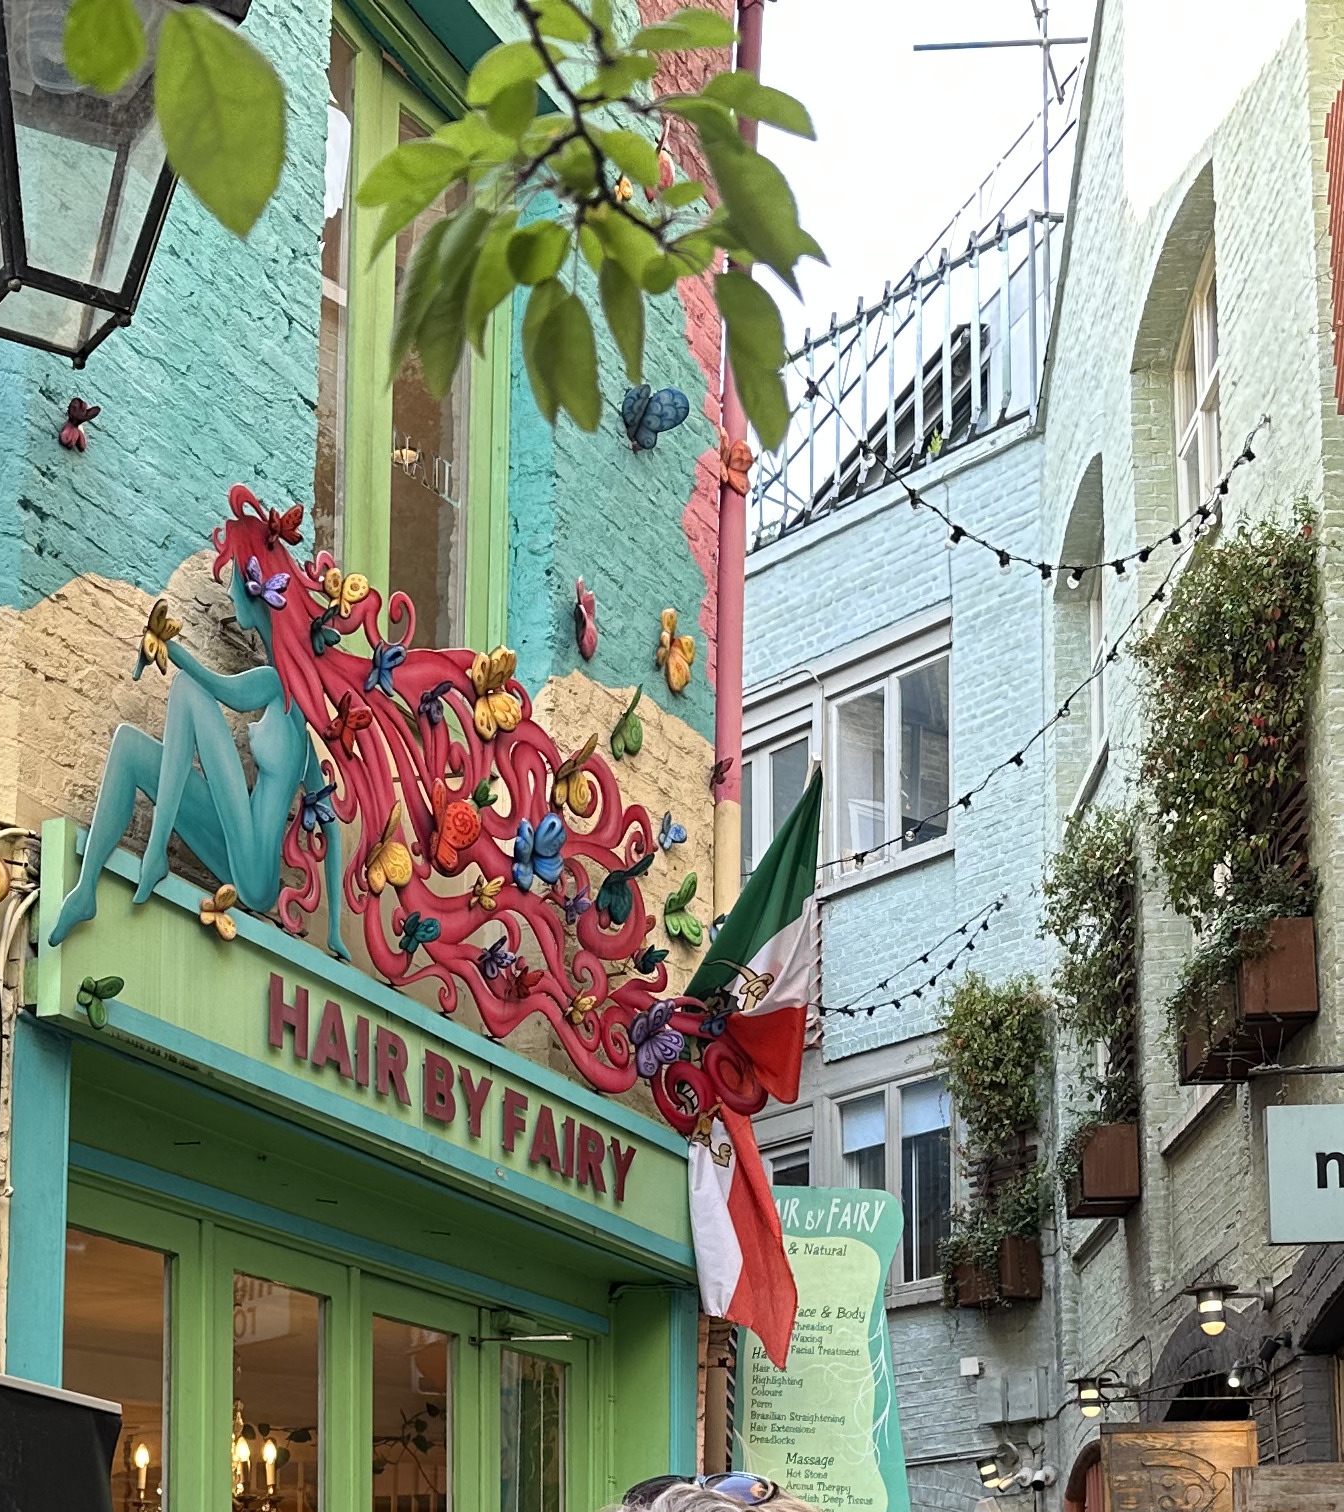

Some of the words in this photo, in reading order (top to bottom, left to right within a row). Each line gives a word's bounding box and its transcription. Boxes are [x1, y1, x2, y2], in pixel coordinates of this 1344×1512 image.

[268, 972, 411, 1107] HAIR
[423, 1048, 493, 1139] BY
[502, 1086, 636, 1202] FAIRY
[805, 1208, 825, 1230] BY
[826, 1198, 886, 1233] FAIRY
[804, 1243, 847, 1256] Natural
[796, 1306, 817, 1318] ace
[821, 1306, 832, 1318] &
[836, 1307, 866, 1323] Body
[791, 1332, 823, 1345] Waxing
[791, 1345, 814, 1355] Facial
[818, 1346, 860, 1356] Treatment
[752, 1363, 770, 1373] Hair
[752, 1375, 803, 1388] Highlighting
[751, 1387, 783, 1396] Colours
[751, 1399, 772, 1408] Perm
[751, 1411, 786, 1420] Brazilian
[790, 1412, 845, 1425] Straightening
[750, 1423, 767, 1432] Hair
[771, 1423, 816, 1433] Extensions
[750, 1435, 795, 1445] Dreadlocks
[785, 1453, 835, 1469] Massage
[786, 1468, 801, 1478] Hot
[804, 1469, 828, 1479] Stone
[817, 1482, 851, 1495] Therapy
[823, 1494, 844, 1507] Deep
[847, 1495, 873, 1505] Tissue
